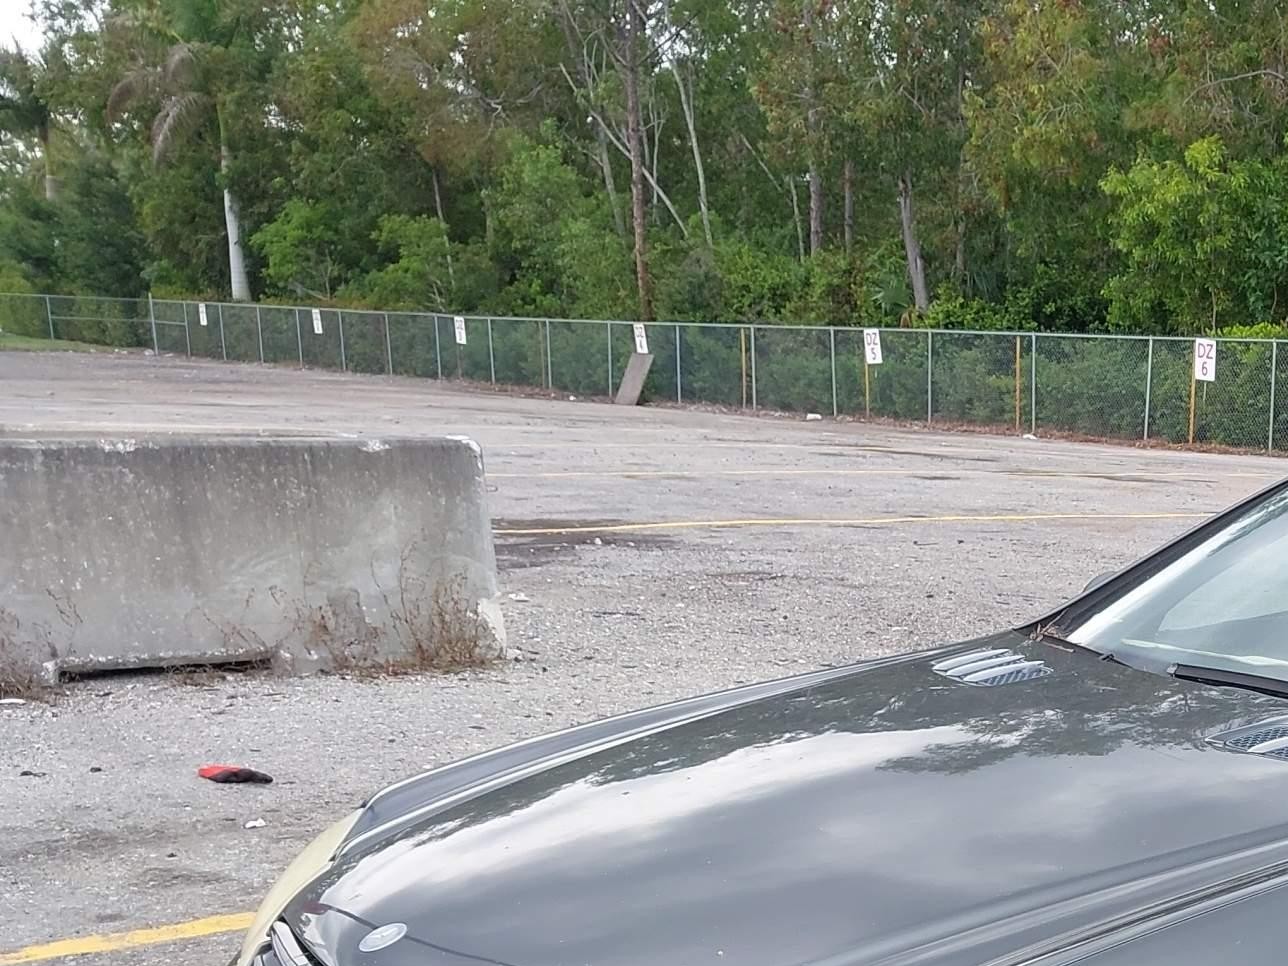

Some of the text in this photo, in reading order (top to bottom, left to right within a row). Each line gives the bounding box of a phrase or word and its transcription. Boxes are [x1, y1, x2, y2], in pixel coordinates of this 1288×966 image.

[866, 332, 878, 346] DZ
[871, 347, 877, 361] 5
[1197, 343, 1214, 360] DZ
[1201, 361, 1208, 376] 6
